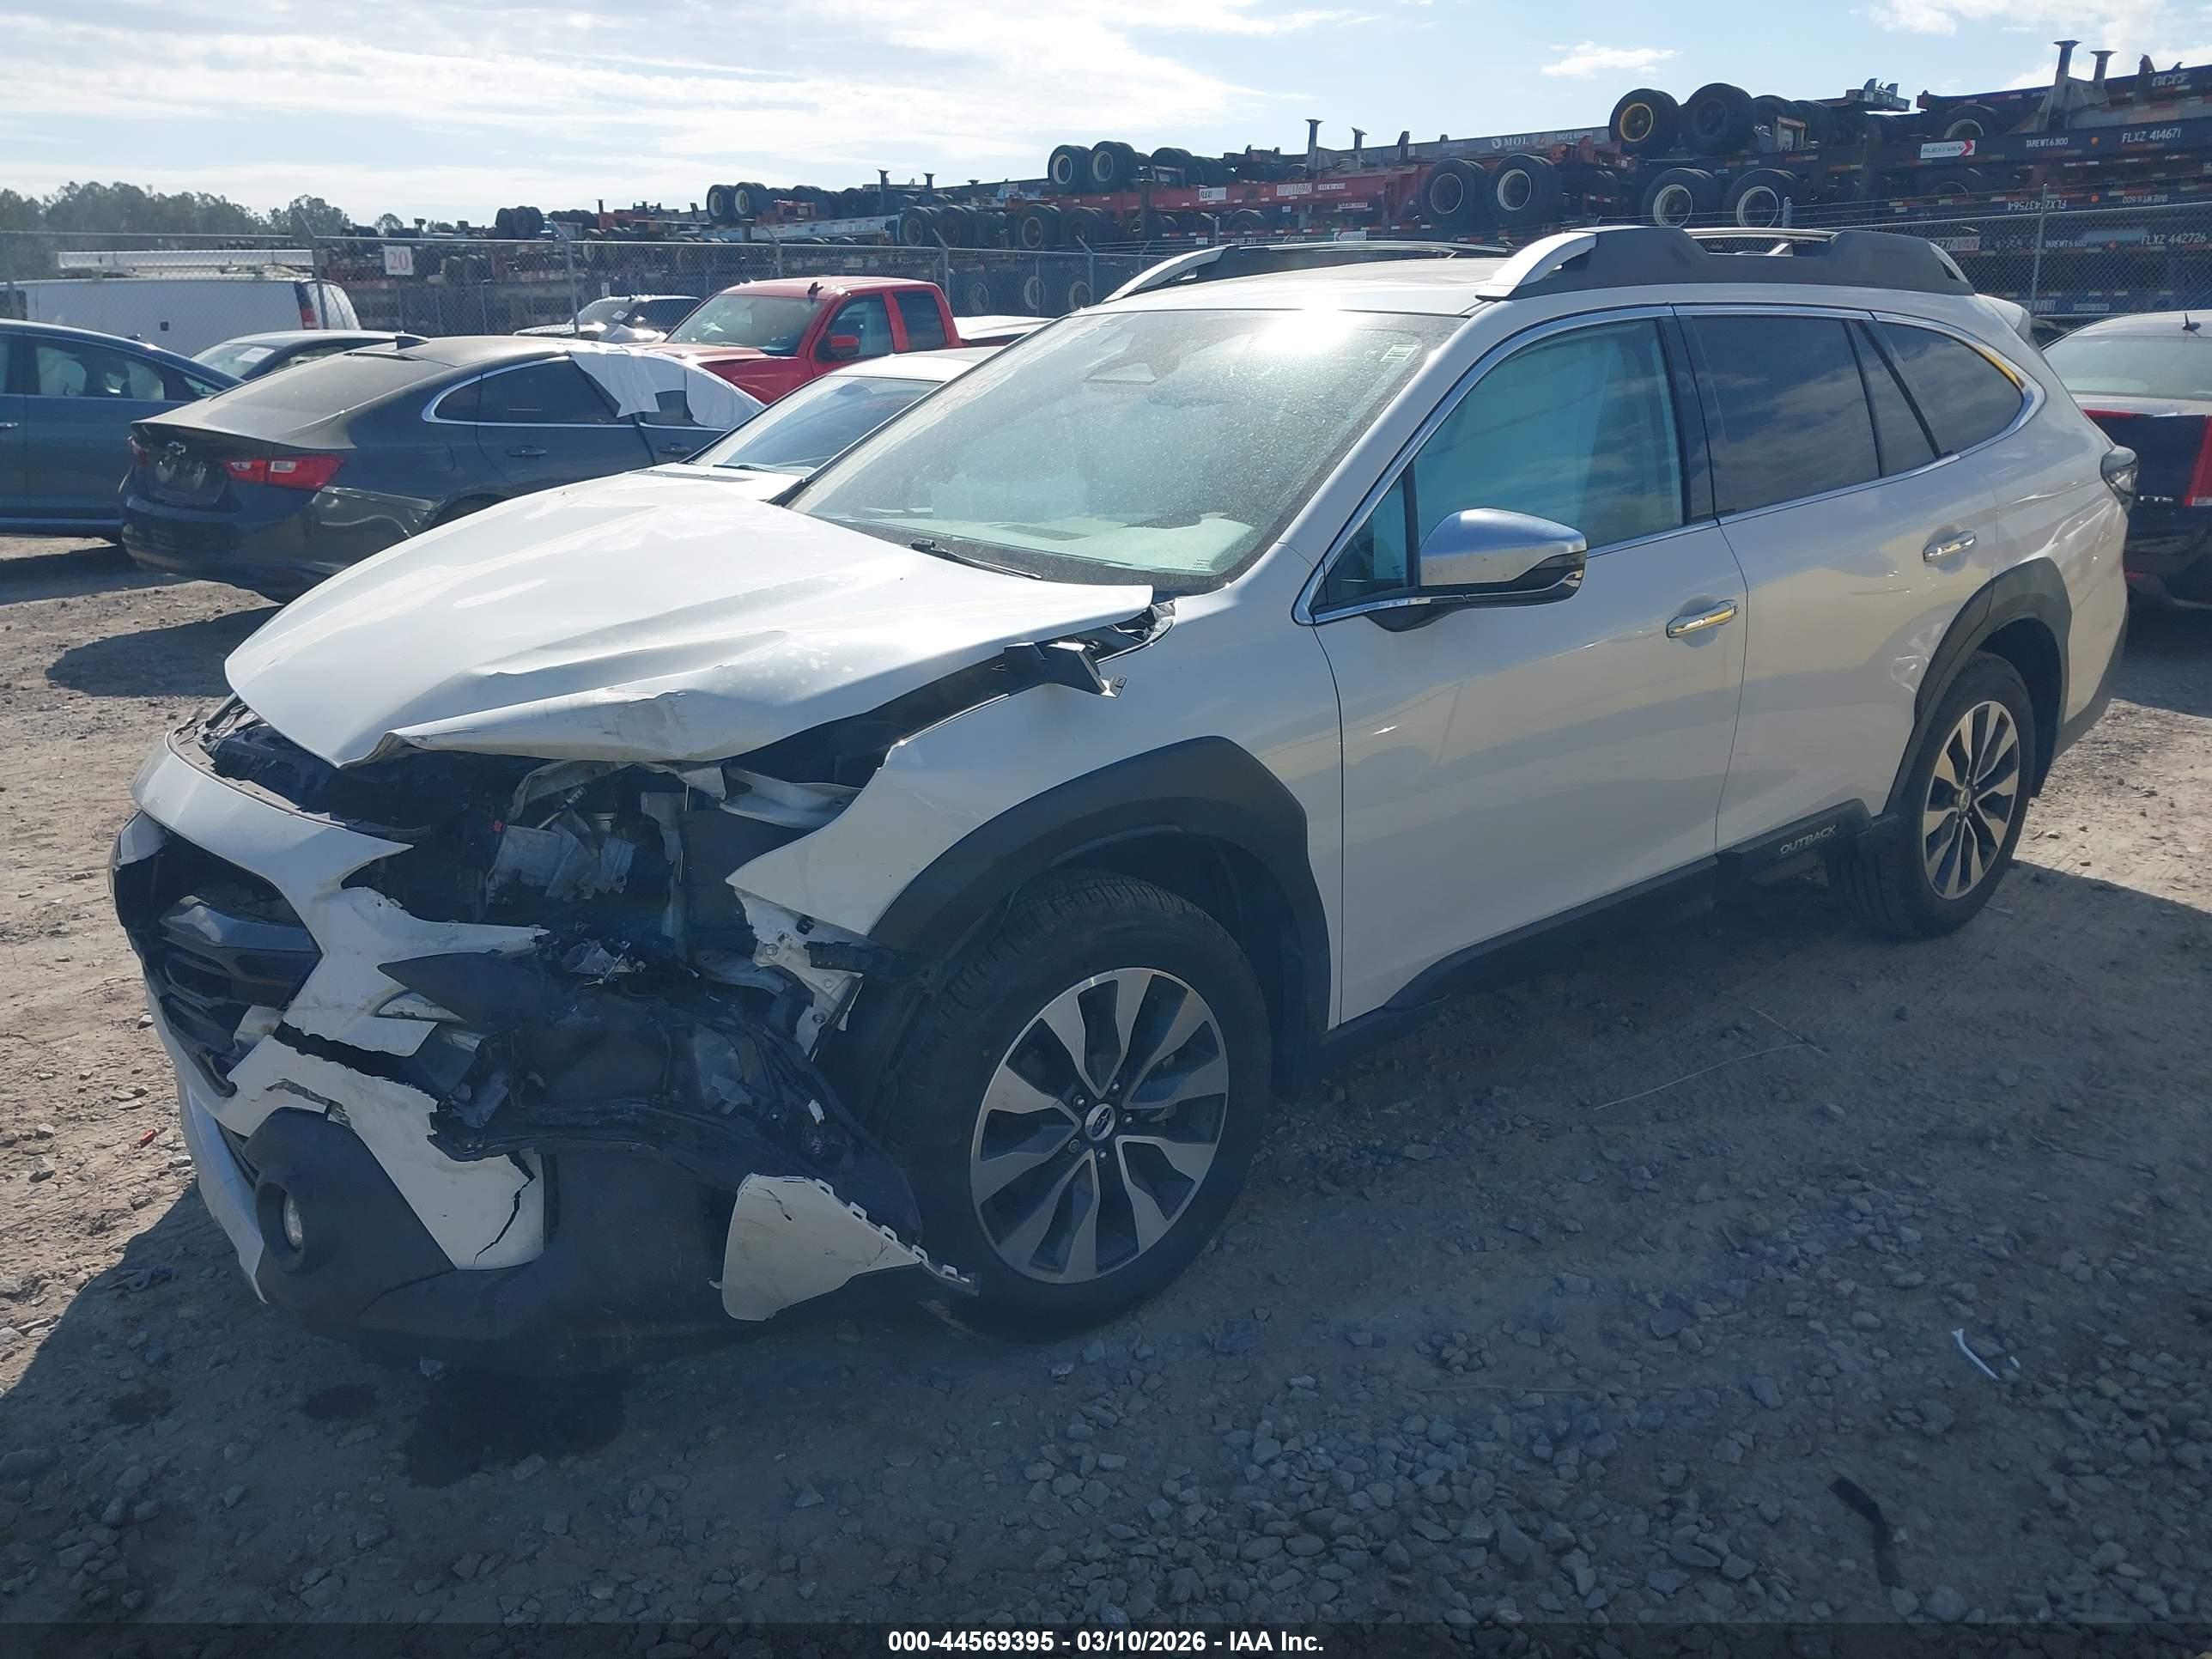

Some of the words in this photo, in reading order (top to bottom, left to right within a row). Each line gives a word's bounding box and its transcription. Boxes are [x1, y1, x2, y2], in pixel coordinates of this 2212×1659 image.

[1504, 137, 1528, 147] MOL
[2122, 131, 2147, 143] FLXZ
[2149, 128, 2181, 141] 414671
[388, 251, 408, 270] 20
[1780, 825, 1836, 854] OUTBACK
